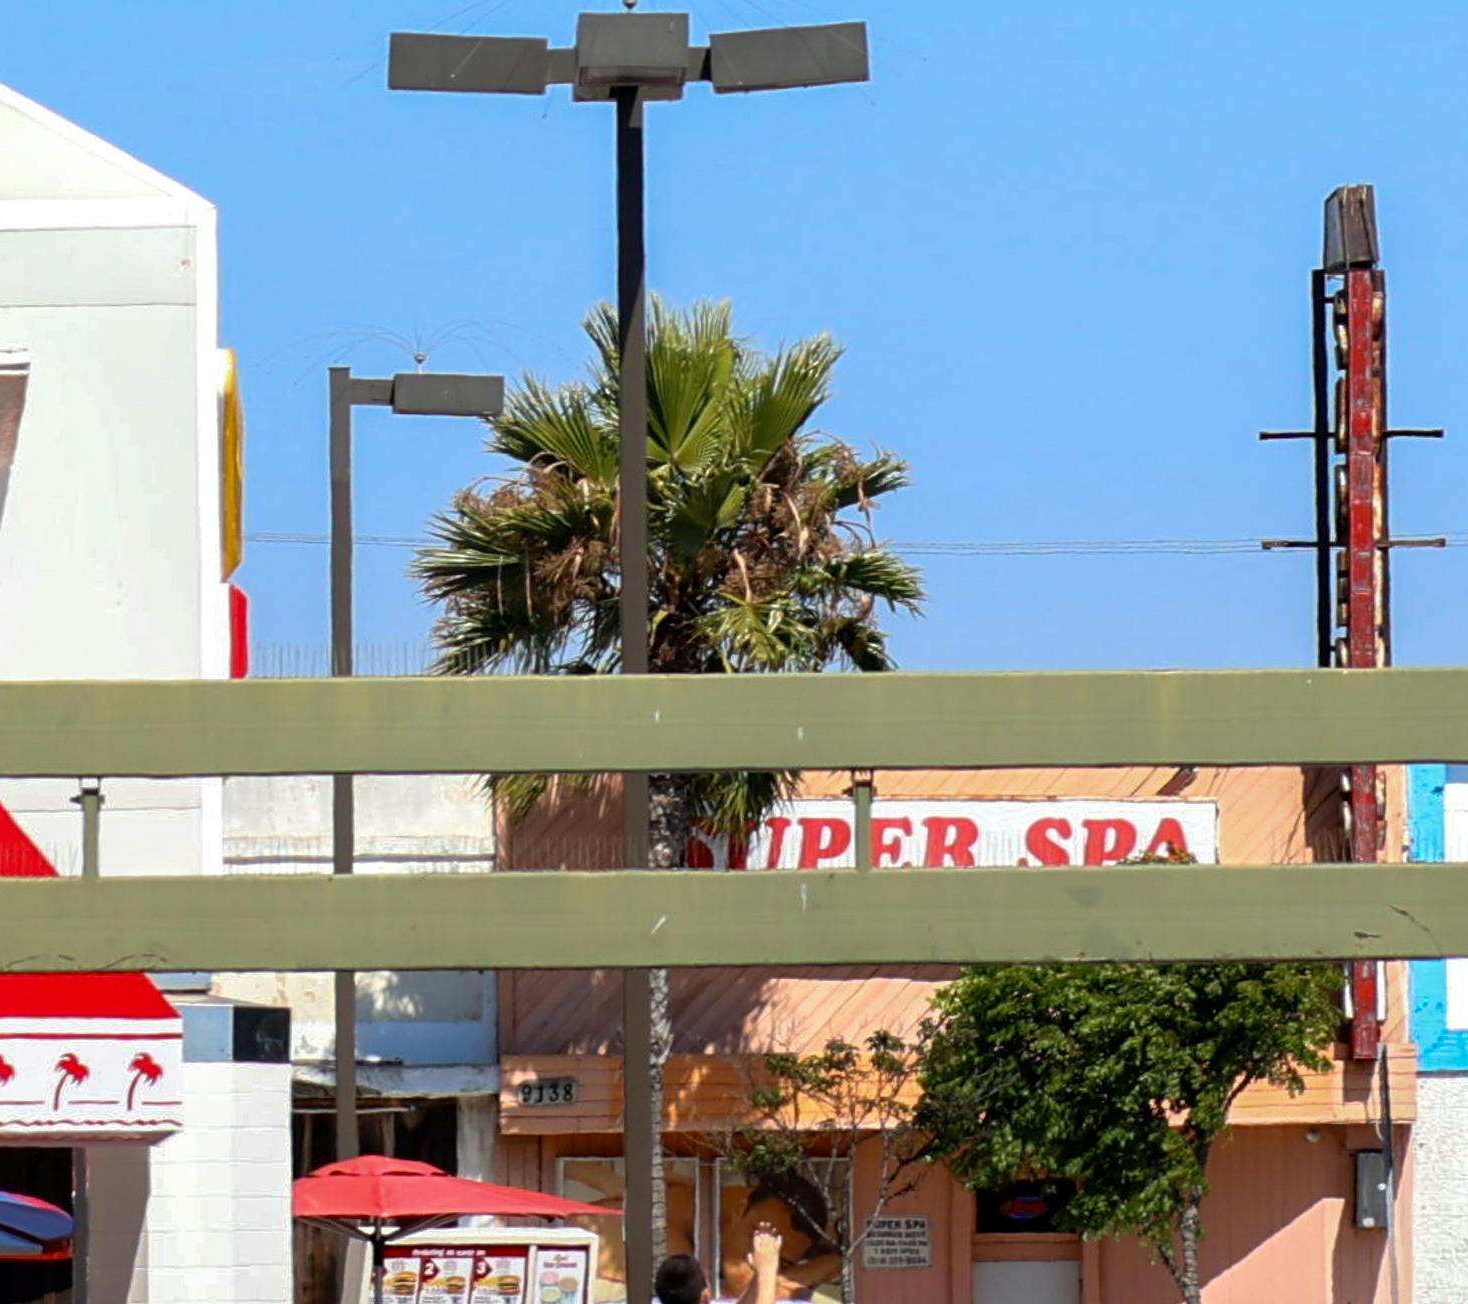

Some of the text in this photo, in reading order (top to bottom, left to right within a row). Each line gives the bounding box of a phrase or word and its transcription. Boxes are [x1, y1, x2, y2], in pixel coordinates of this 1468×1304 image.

[1018, 817, 1190, 868] SPA
[521, 1083, 574, 1104] 9138
[424, 1262, 433, 1275] 2
[476, 1262, 485, 1274] 3
